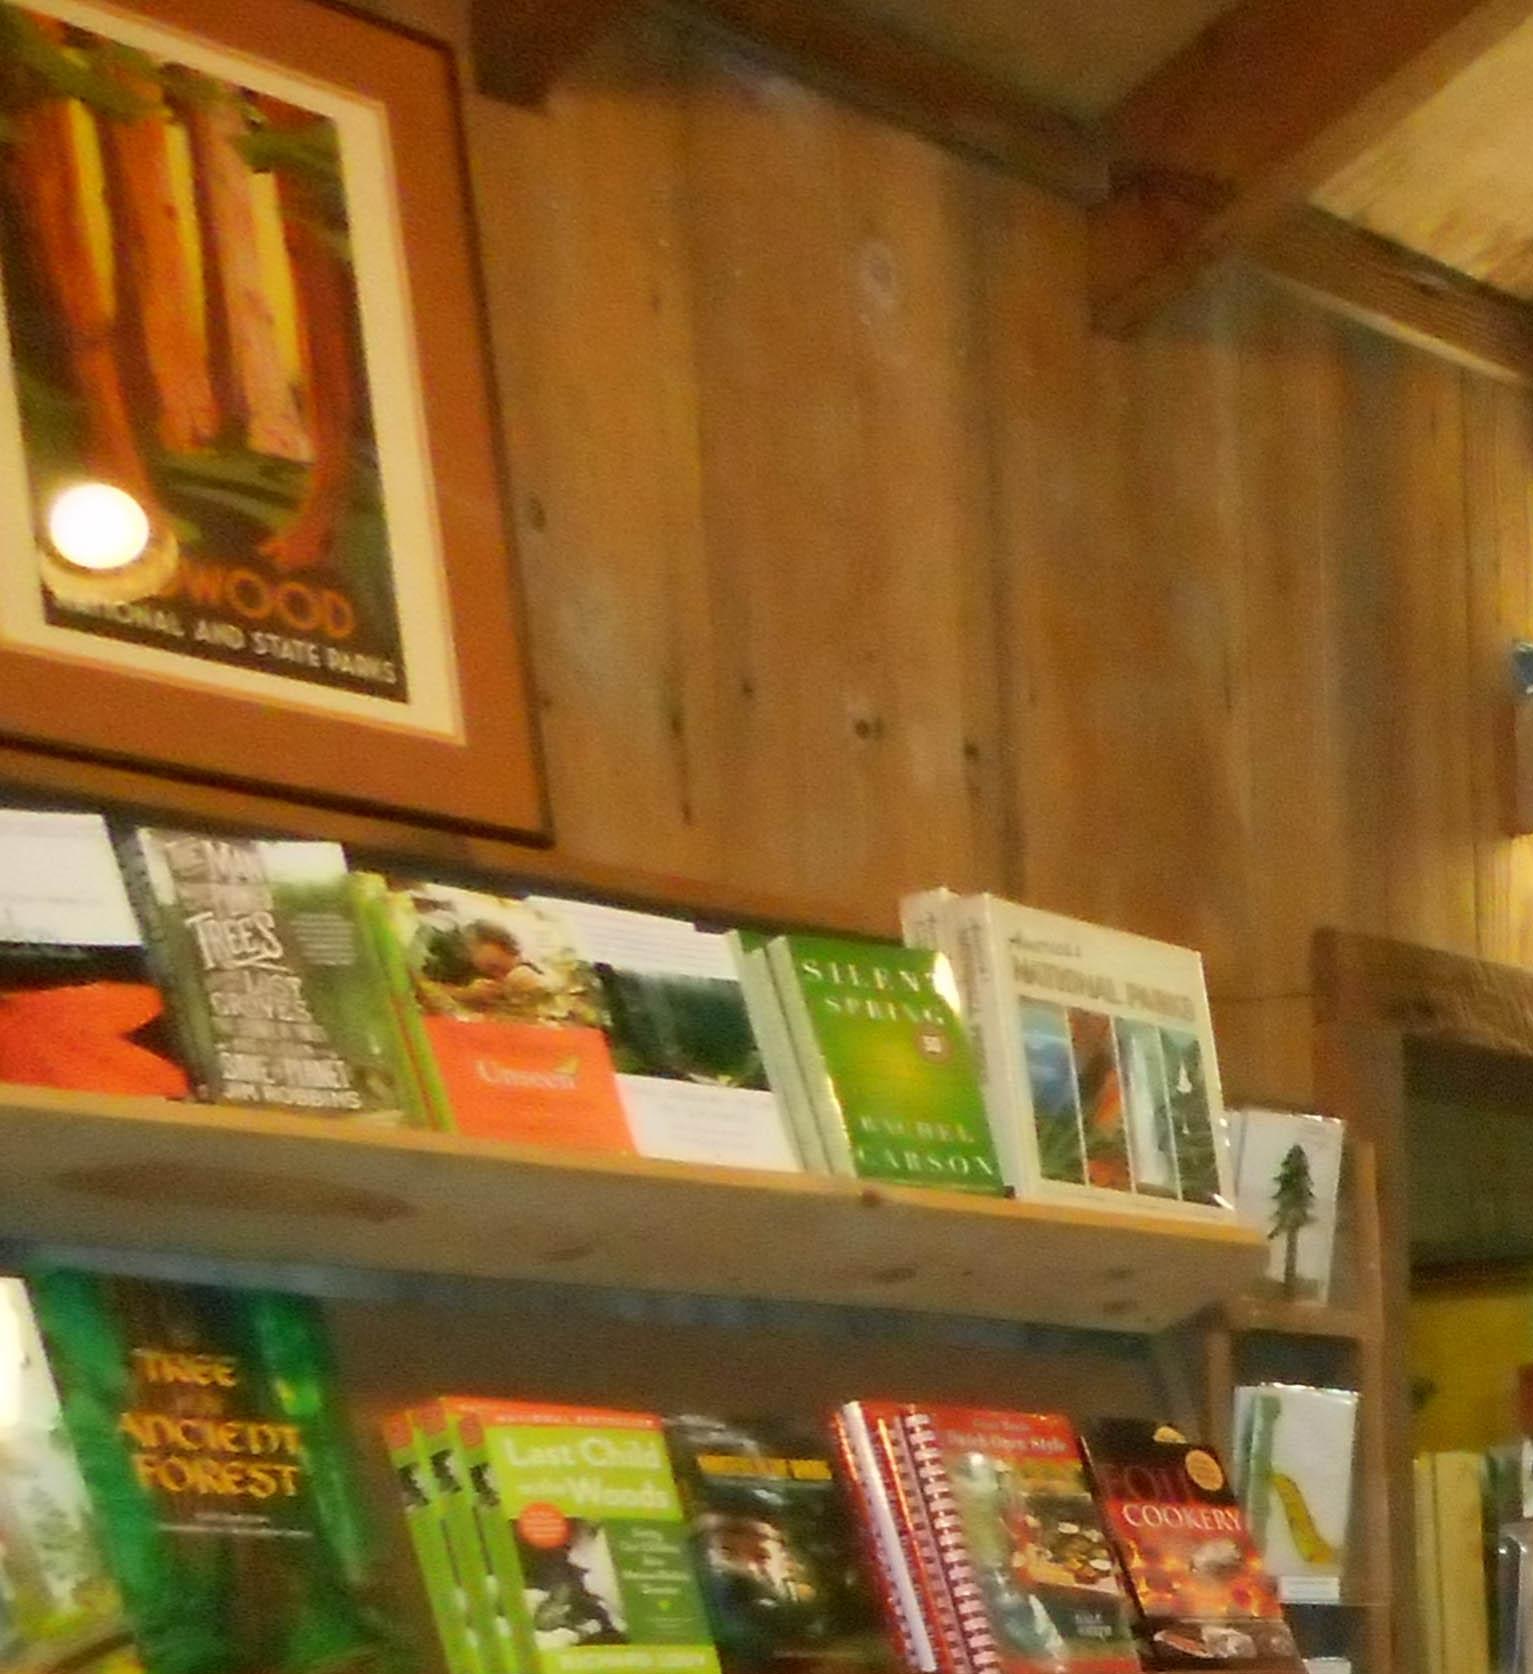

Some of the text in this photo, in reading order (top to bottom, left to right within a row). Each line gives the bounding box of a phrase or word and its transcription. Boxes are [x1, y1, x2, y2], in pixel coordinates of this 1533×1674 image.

[194, 620, 245, 652] AND
[252, 632, 322, 669] STATE
[327, 648, 397, 686] PARKS
[184, 910, 283, 971] TREES
[132, 1452, 301, 1499] FOREST
[502, 1436, 664, 1469] Last Child
[1123, 1504, 1243, 1531] COOKERY
